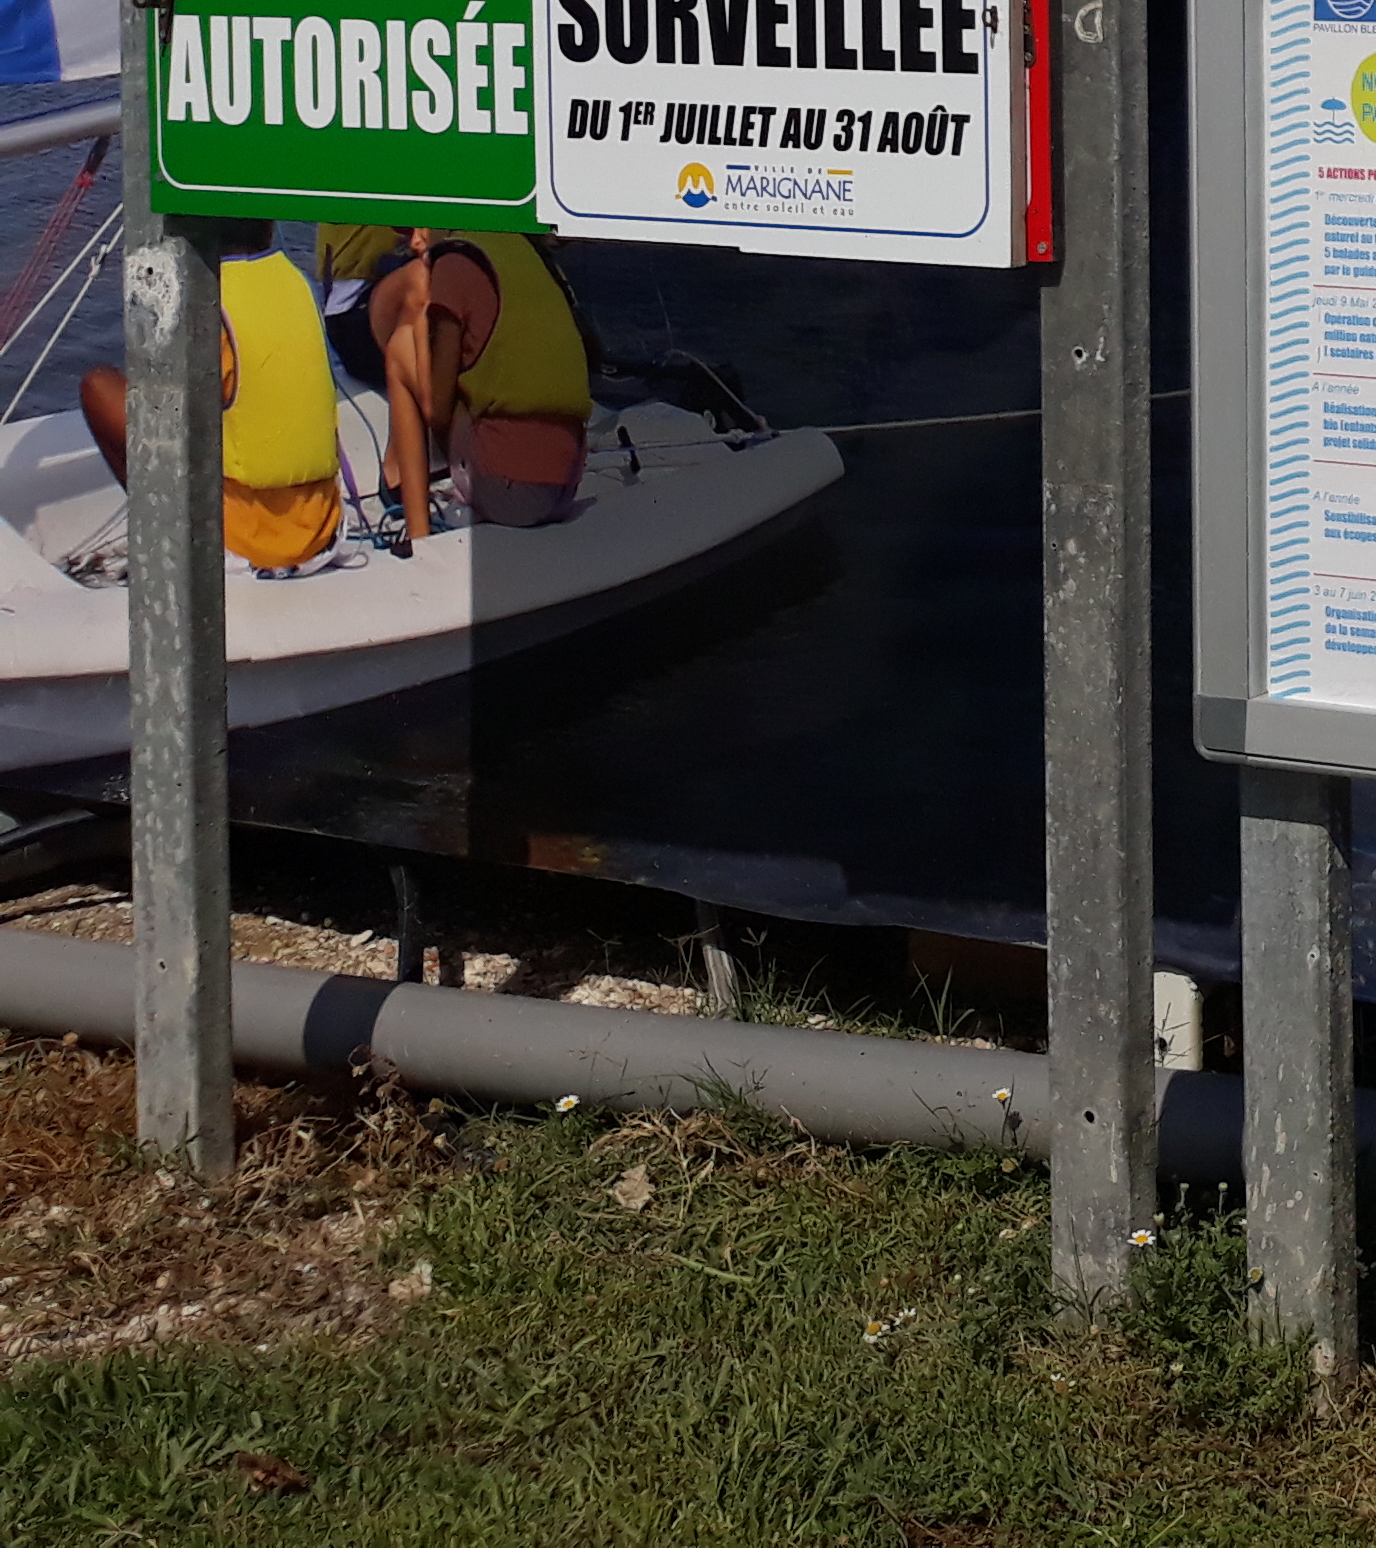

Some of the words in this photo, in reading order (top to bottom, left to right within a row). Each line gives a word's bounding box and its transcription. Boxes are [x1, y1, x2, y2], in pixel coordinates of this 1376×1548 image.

[167, 0, 528, 135] AUTORISÉE
[568, 99, 611, 140] DU
[660, 103, 776, 147] JUILLET
[780, 108, 826, 150] AU
[833, 109, 872, 151] 31
[877, 105, 970, 156] AOÛT
[724, 201, 759, 211] entre
[766, 202, 804, 214] soleil
[812, 205, 825, 215] et
[832, 208, 854, 217] eau
[726, 175, 853, 202] MARIGNANE
